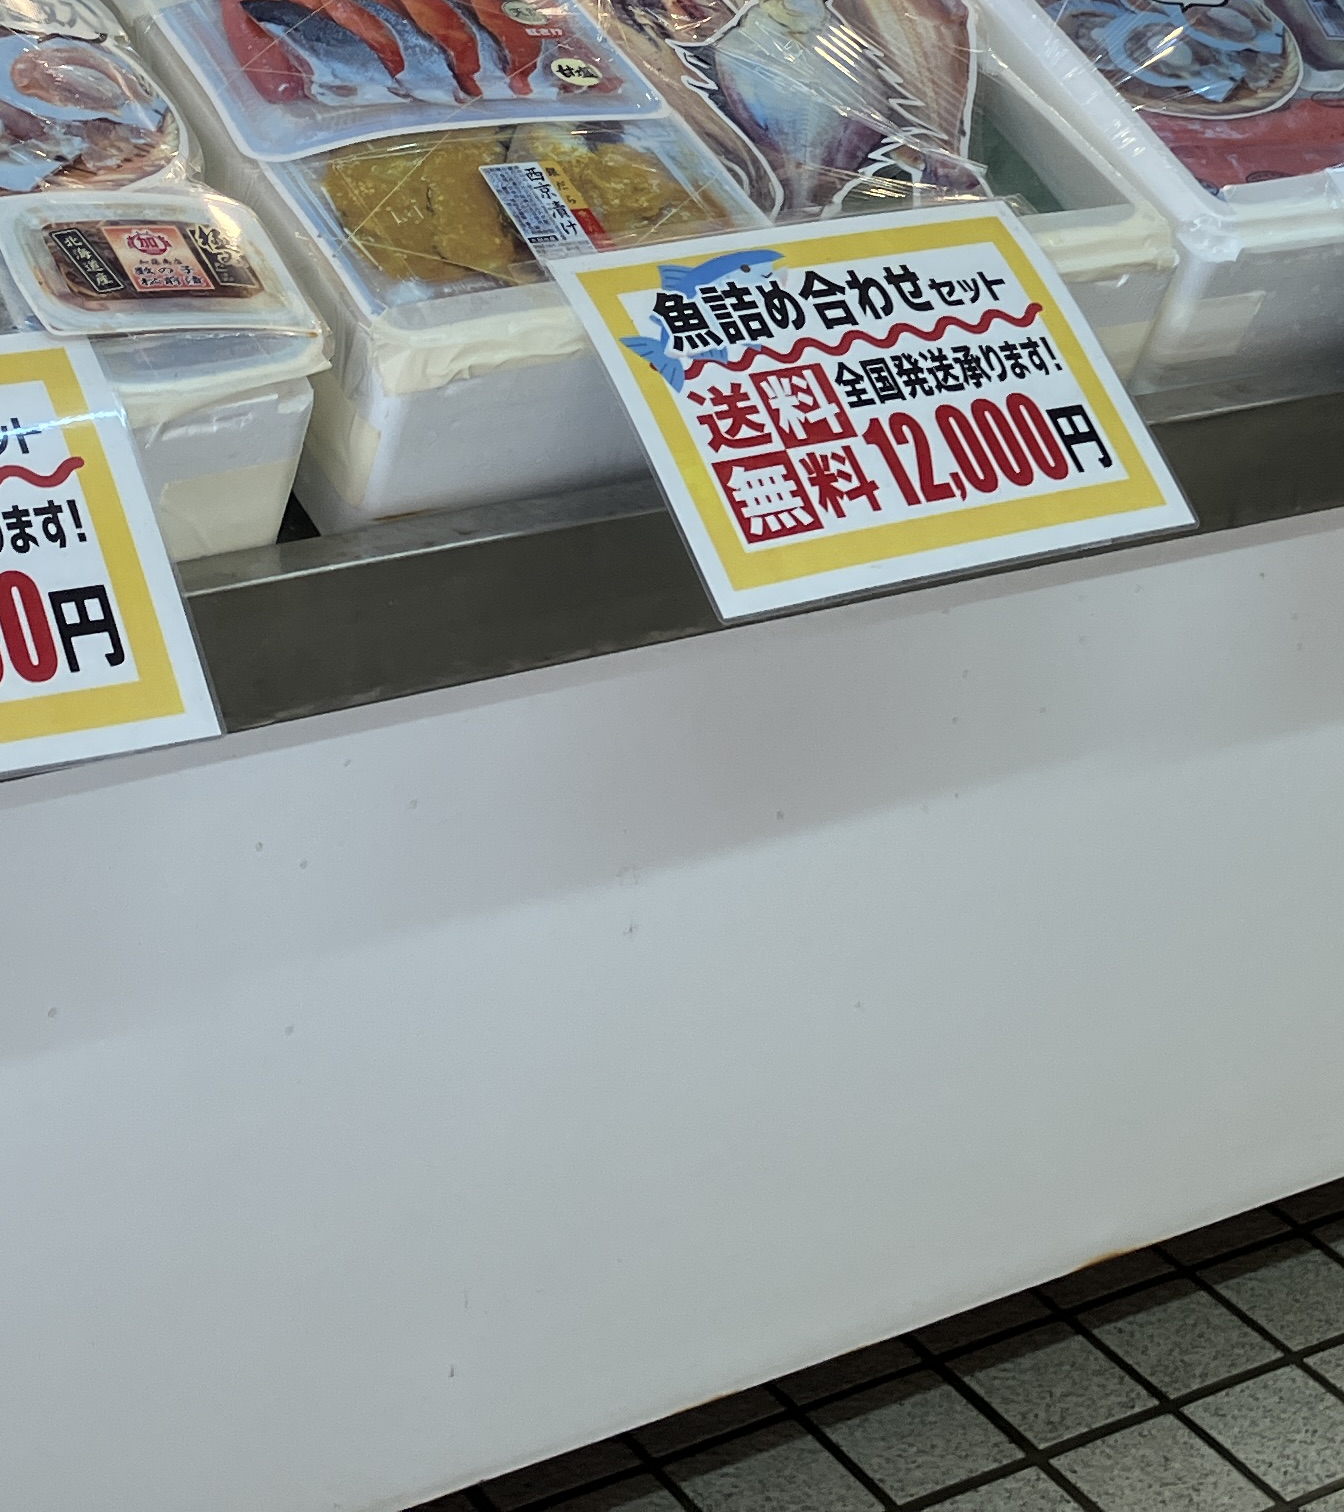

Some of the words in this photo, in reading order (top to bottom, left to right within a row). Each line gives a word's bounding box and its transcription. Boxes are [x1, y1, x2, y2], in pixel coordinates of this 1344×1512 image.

[525, 167, 578, 235] 西京漬け
[64, 235, 114, 287] 北海道産
[652, 263, 1007, 354] 魚詰め合わせセット
[686, 368, 854, 454] 送料
[834, 336, 1063, 410] 全国発送承ります!
[726, 445, 881, 541] 無料
[862, 392, 1113, 507] 12,000円
